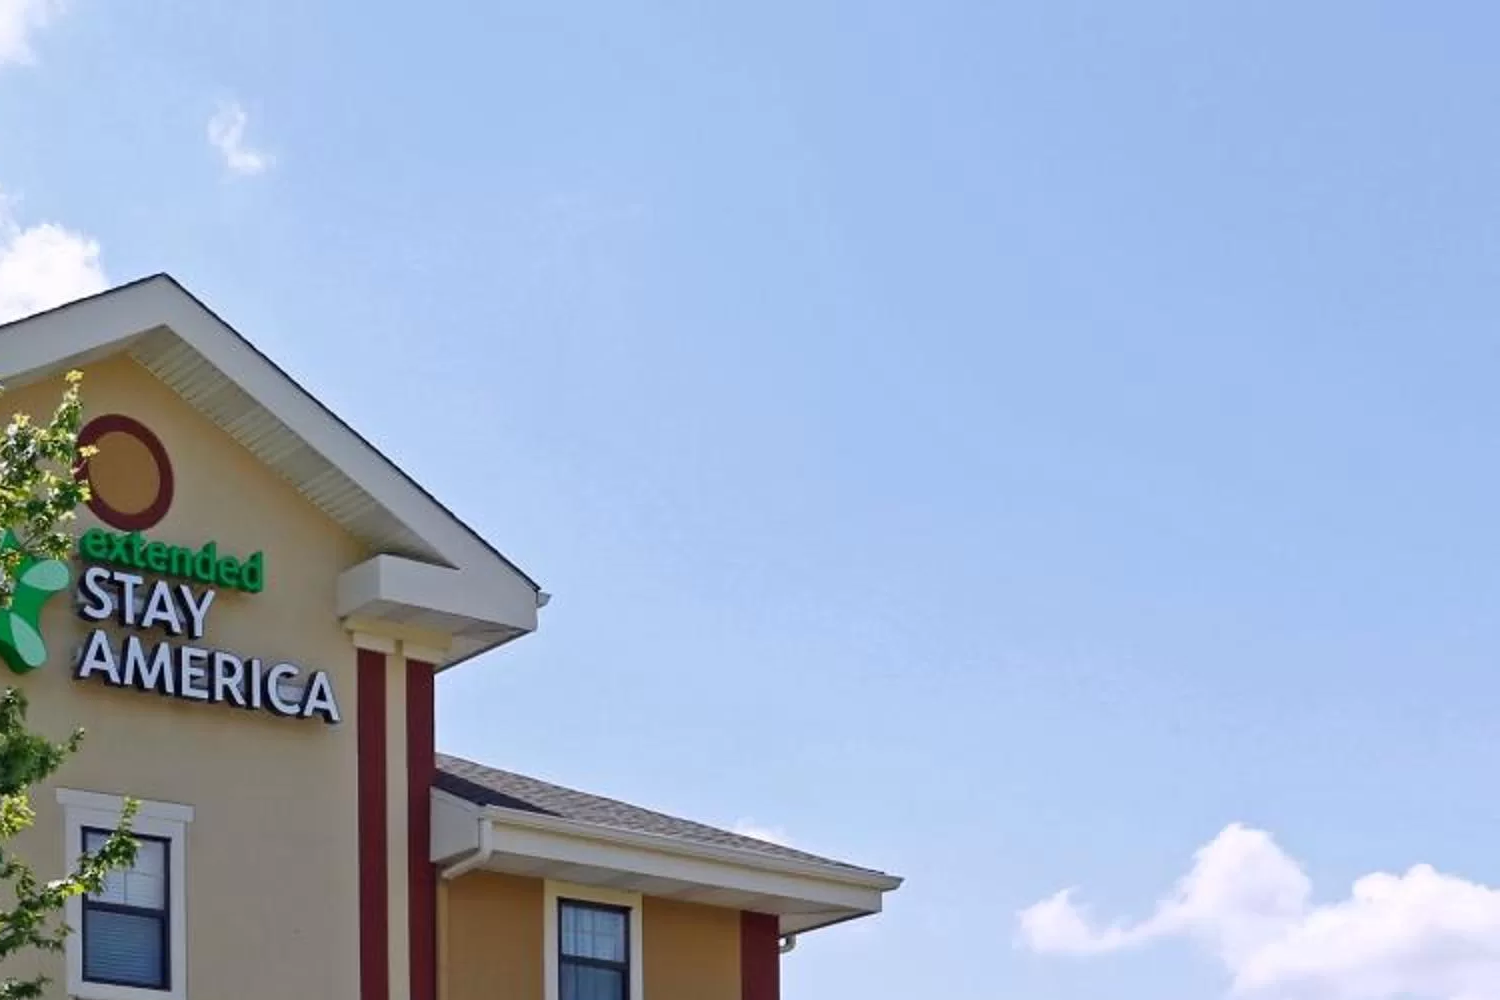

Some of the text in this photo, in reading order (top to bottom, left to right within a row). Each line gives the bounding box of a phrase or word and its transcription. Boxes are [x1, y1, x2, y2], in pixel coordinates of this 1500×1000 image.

[80, 527, 263, 593] extended
[82, 566, 216, 638] STAY
[78, 628, 341, 723] AMERICA
